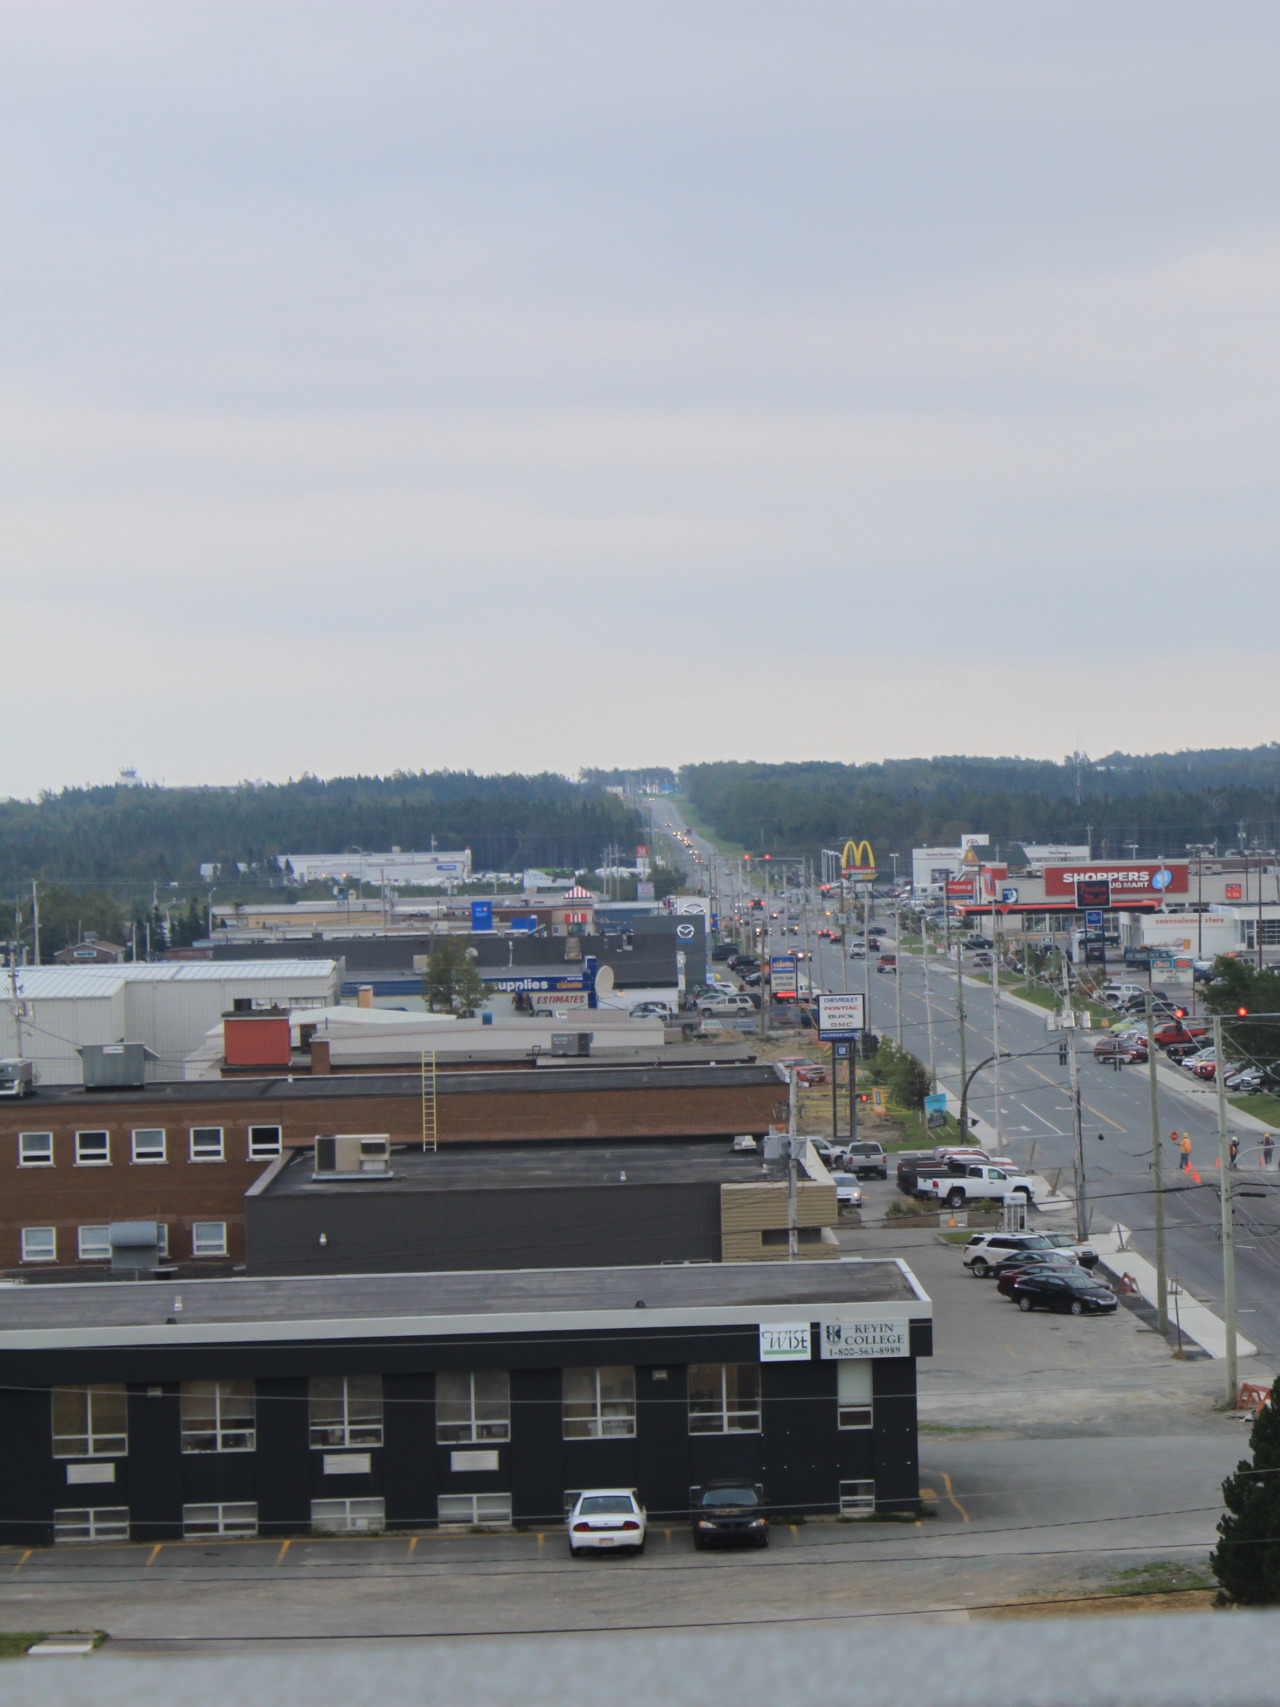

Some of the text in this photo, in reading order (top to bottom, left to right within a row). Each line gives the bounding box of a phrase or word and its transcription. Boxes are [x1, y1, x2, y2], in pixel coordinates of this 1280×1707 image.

[1063, 871, 1149, 883] SHOPPERS
[537, 995, 585, 1004] ESTIMATES
[855, 1323, 894, 1334] KEYIN
[761, 1329, 808, 1349] WISE
[844, 1334, 905, 1345] COLLEGE
[829, 1346, 901, 1357] 1-800-563-8989
